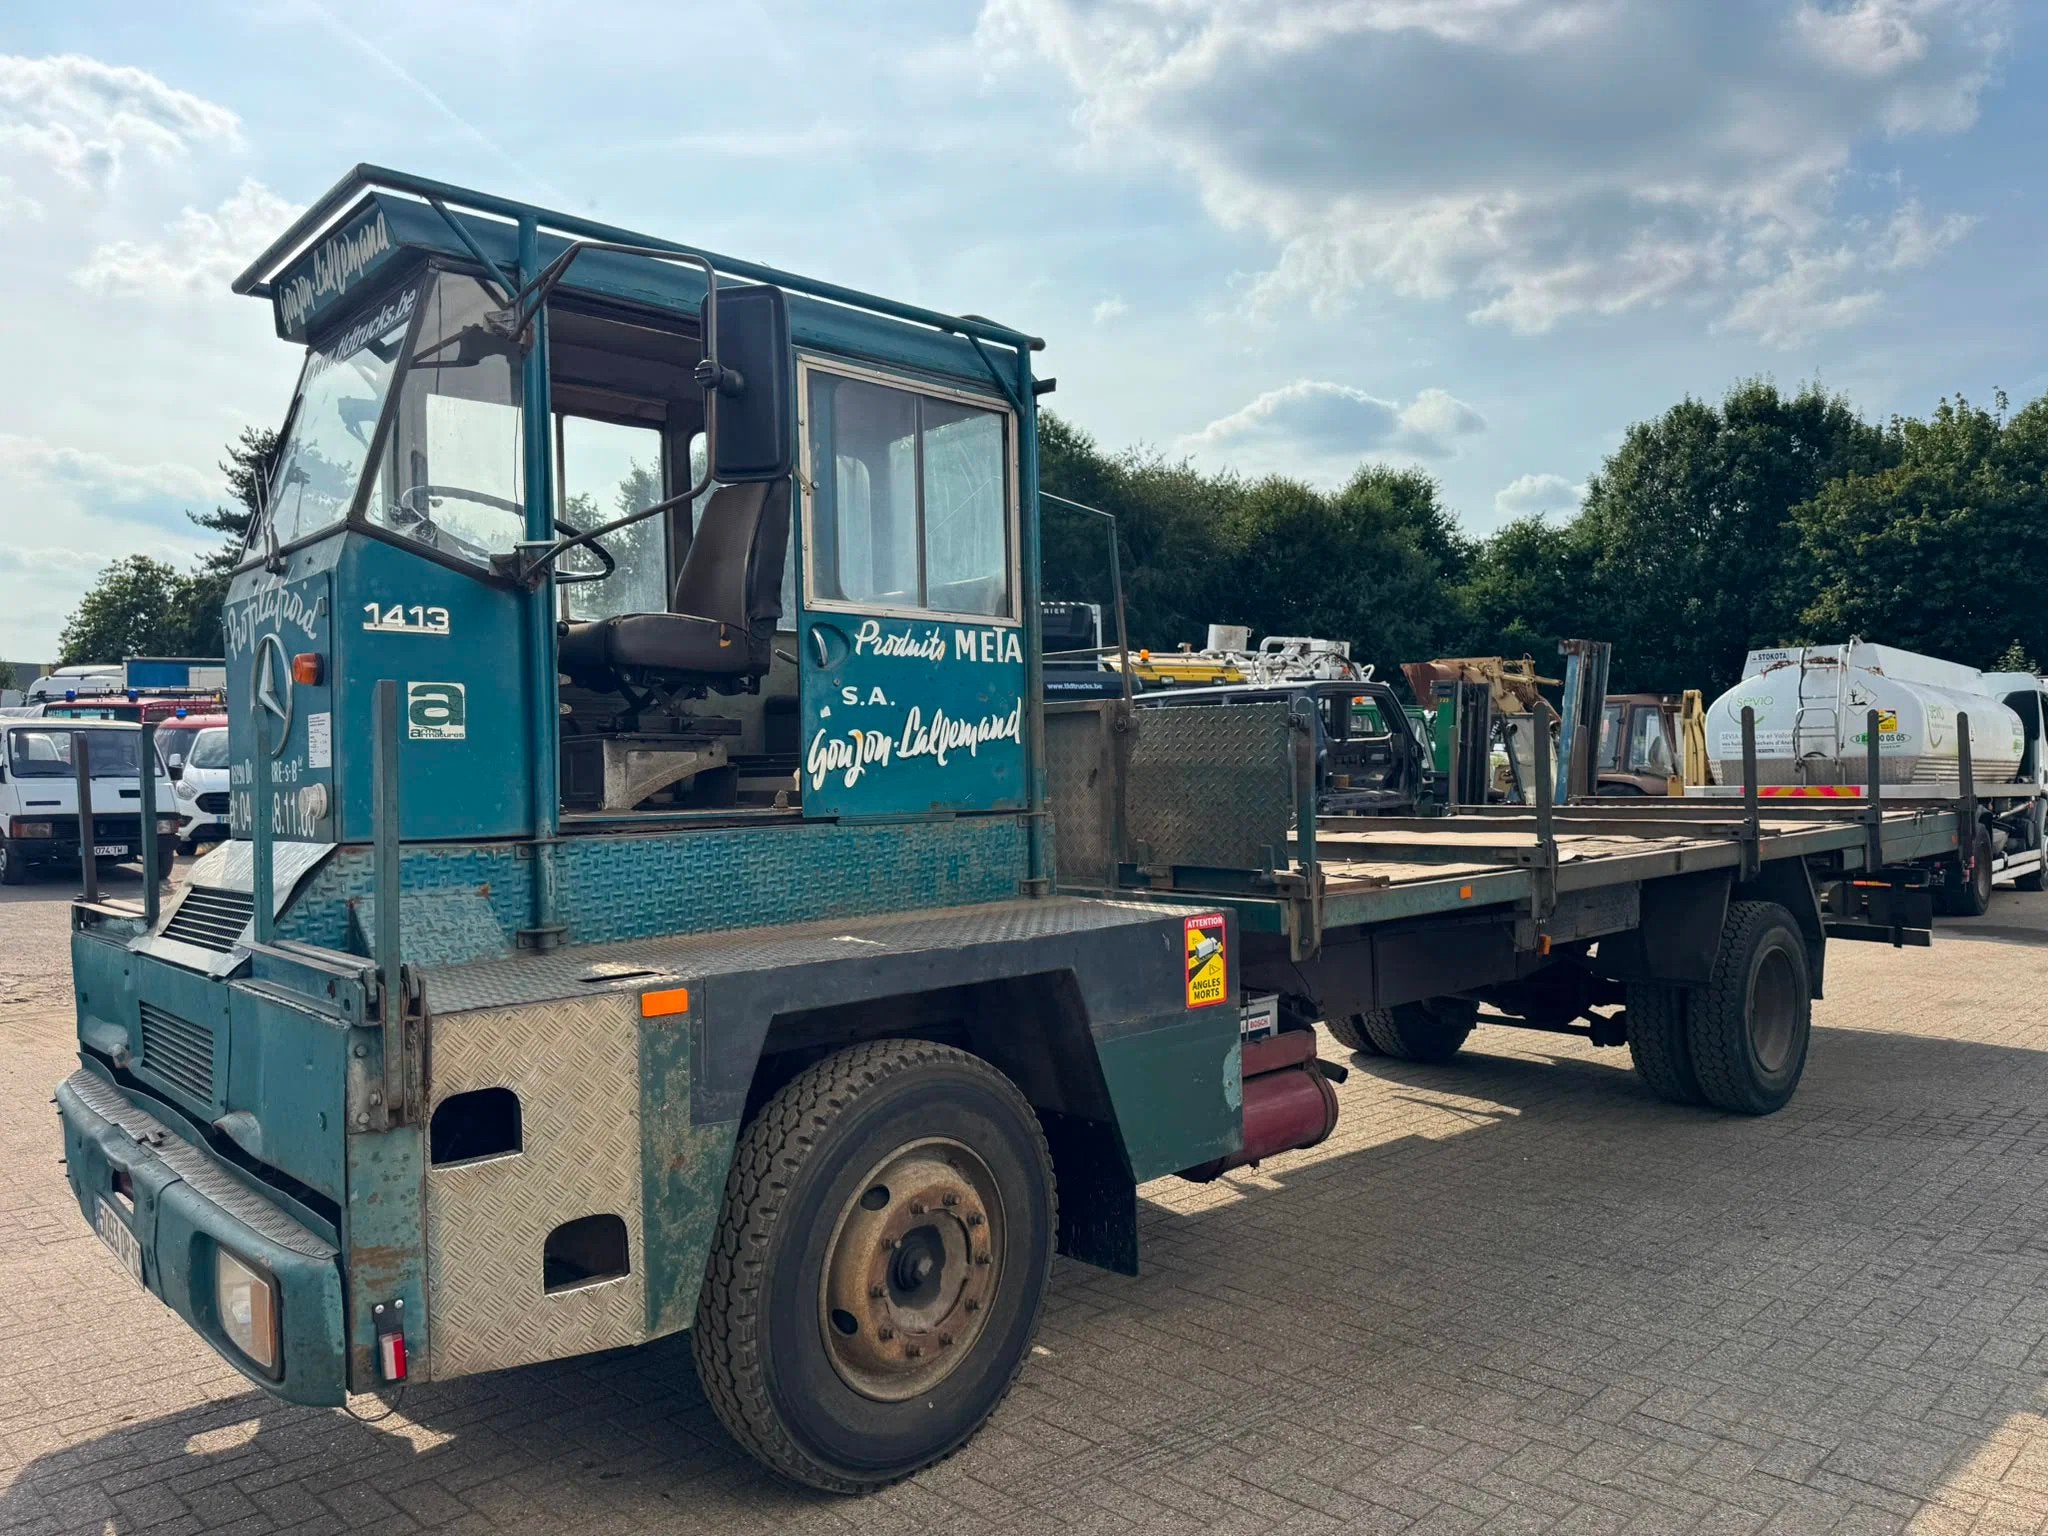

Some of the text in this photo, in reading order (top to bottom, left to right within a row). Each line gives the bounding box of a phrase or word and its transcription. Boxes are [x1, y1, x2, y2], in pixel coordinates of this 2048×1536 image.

[363, 603, 450, 630] 1413
[854, 620, 1023, 663] Produits META
[1758, 652, 1787, 661] STOKOTA
[841, 686, 896, 706] S.A.
[1187, 917, 1223, 929] ATTENTION
[1192, 977, 1221, 990] ANGLES
[1193, 987, 1220, 1000] MORTS
